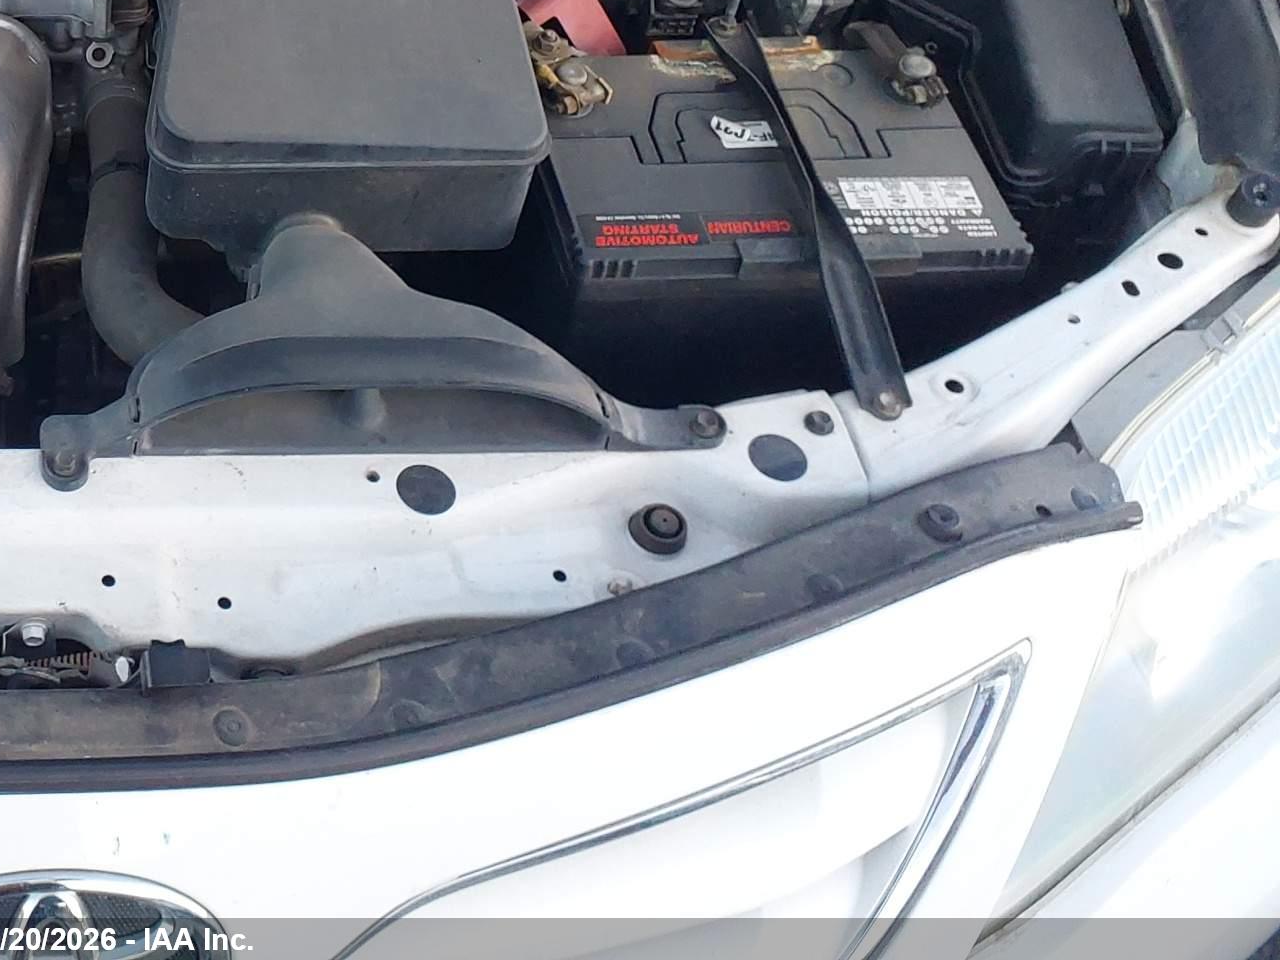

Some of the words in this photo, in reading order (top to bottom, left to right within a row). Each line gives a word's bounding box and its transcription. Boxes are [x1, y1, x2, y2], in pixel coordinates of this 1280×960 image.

[602, 223, 679, 235] STARTING
[709, 220, 791, 234] CENTURIAN
[596, 234, 699, 247] AUTOMOTIVE
